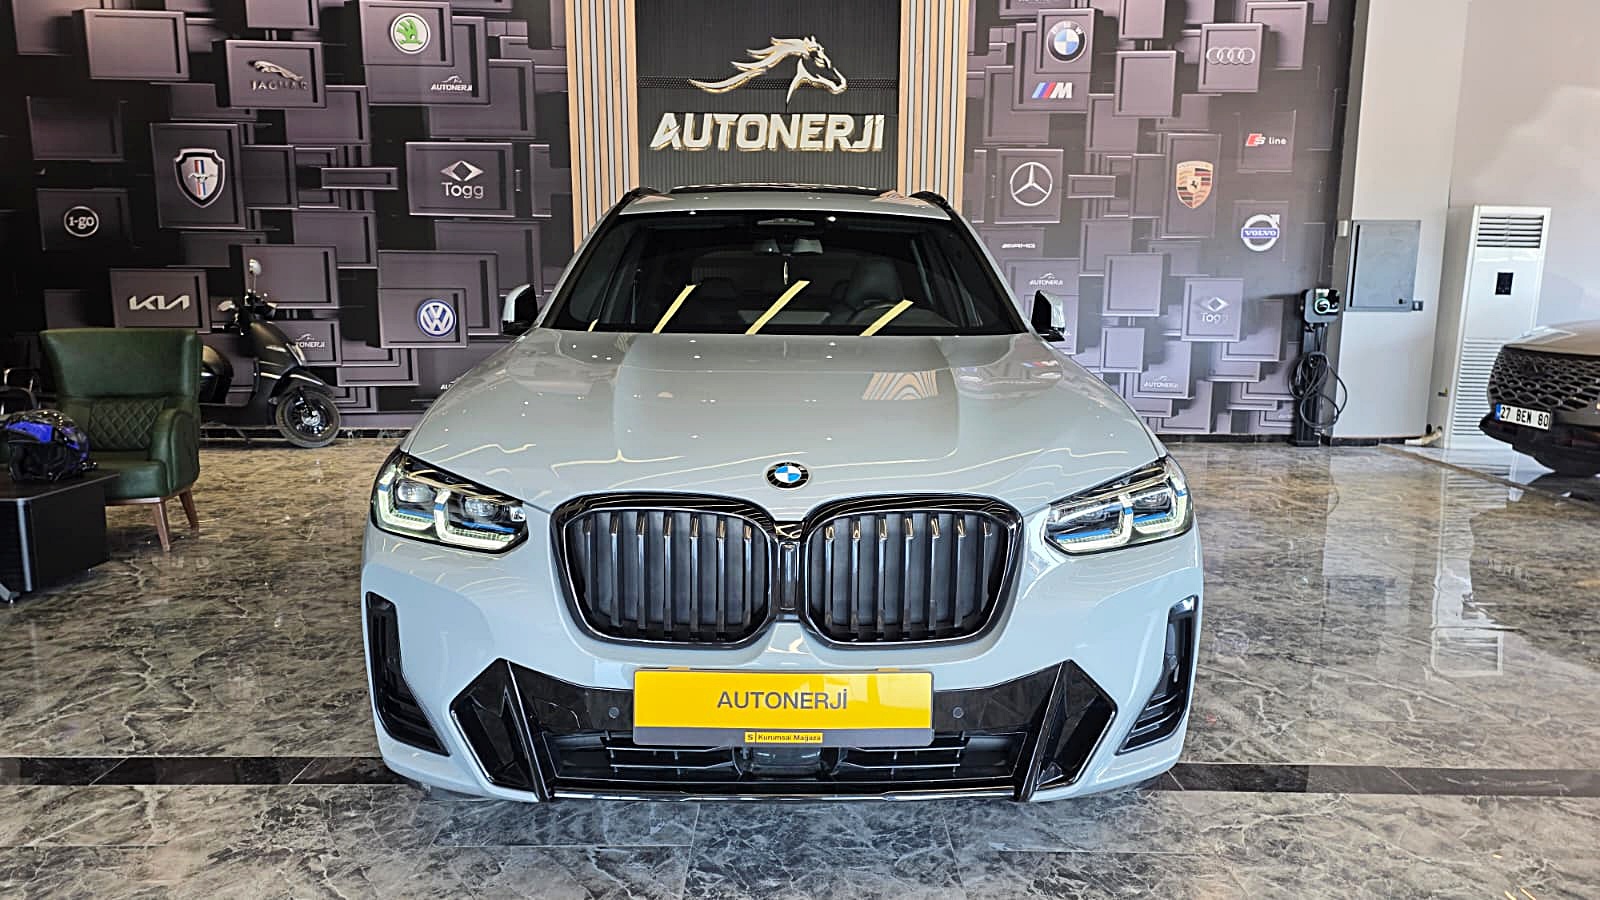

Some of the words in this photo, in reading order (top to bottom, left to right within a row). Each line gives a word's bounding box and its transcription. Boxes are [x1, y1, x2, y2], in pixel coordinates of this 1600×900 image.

[650, 112, 885, 152] AUTONERJI
[1268, 136, 1287, 145] line
[441, 182, 484, 199] Togg
[1501, 406, 1512, 420] 27
[1516, 408, 1532, 425] BEN
[1538, 413, 1549, 427] 80
[758, 733, 792, 741] Kurumsal
